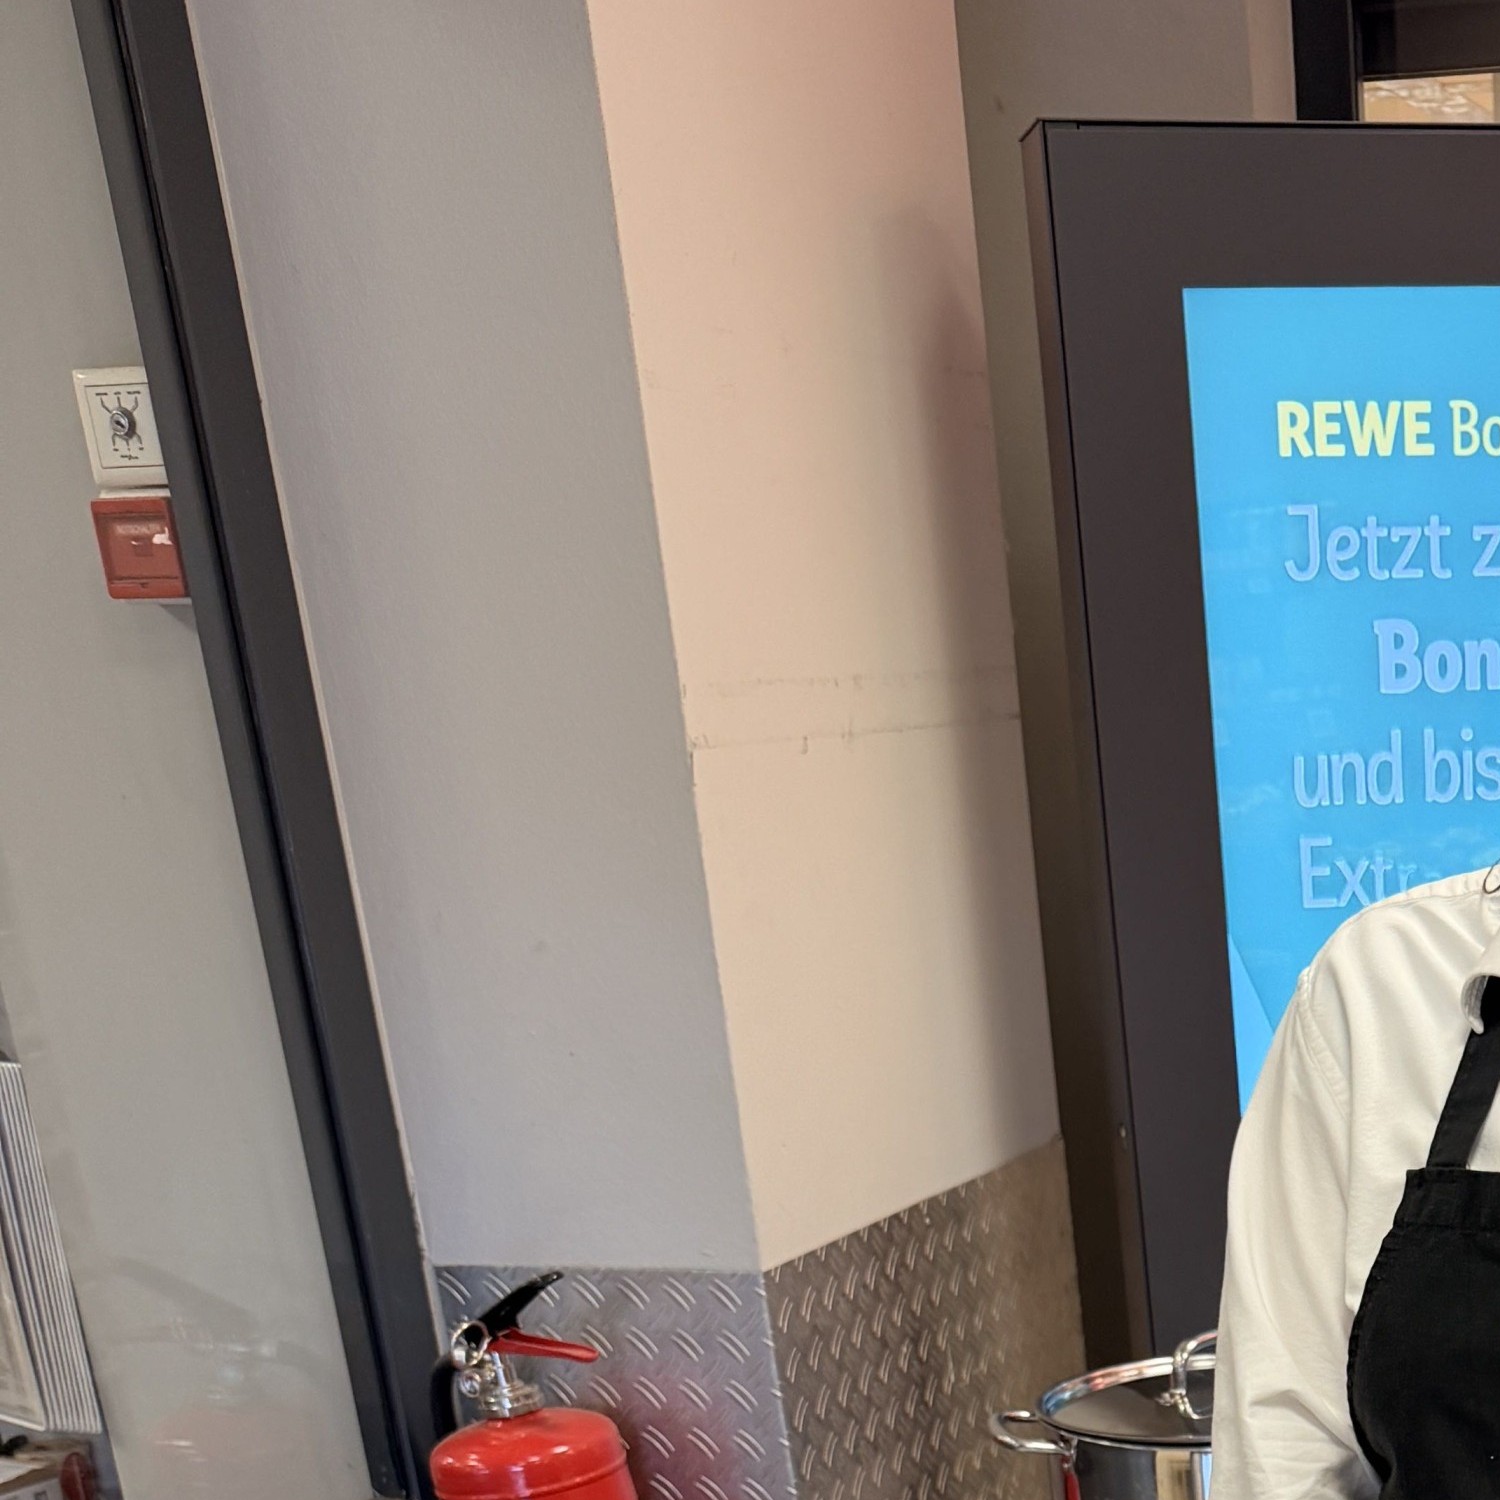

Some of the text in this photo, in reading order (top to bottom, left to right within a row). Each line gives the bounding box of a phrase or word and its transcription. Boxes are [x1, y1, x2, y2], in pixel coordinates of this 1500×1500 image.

[1277, 400, 1435, 458] REWE
[1285, 503, 1452, 583] Jetzt
[1293, 727, 1404, 809] und
[1299, 836, 1420, 909] Extr
